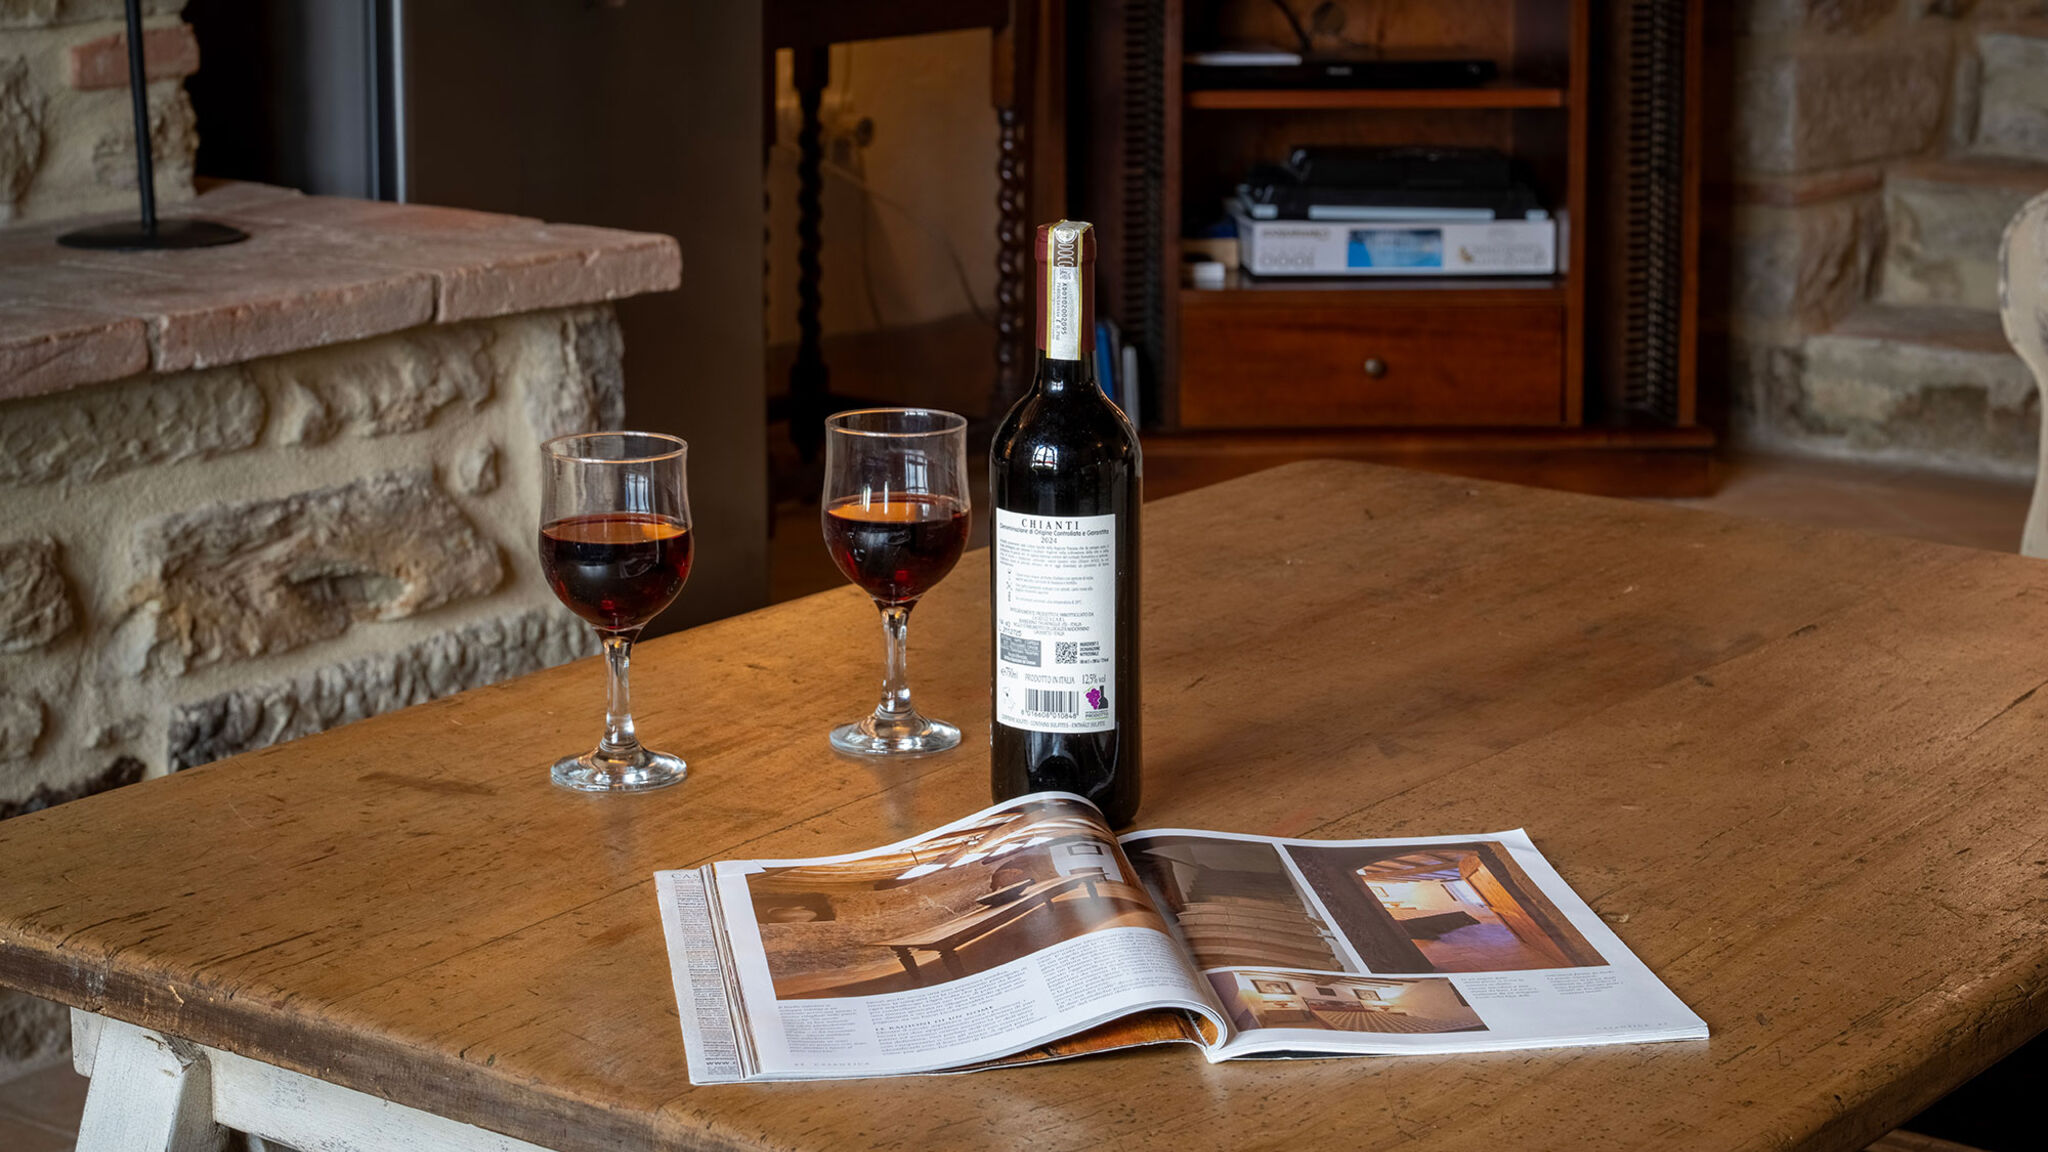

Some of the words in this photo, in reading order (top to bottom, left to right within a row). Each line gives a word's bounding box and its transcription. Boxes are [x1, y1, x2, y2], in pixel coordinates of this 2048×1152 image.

[1021, 518, 1079, 530] CHIANTI
[1034, 529, 1053, 537] Origine
[1024, 673, 1051, 683] PRODOTTO
[1052, 675, 1058, 683] IN
[1058, 675, 1075, 684] ITALIA
